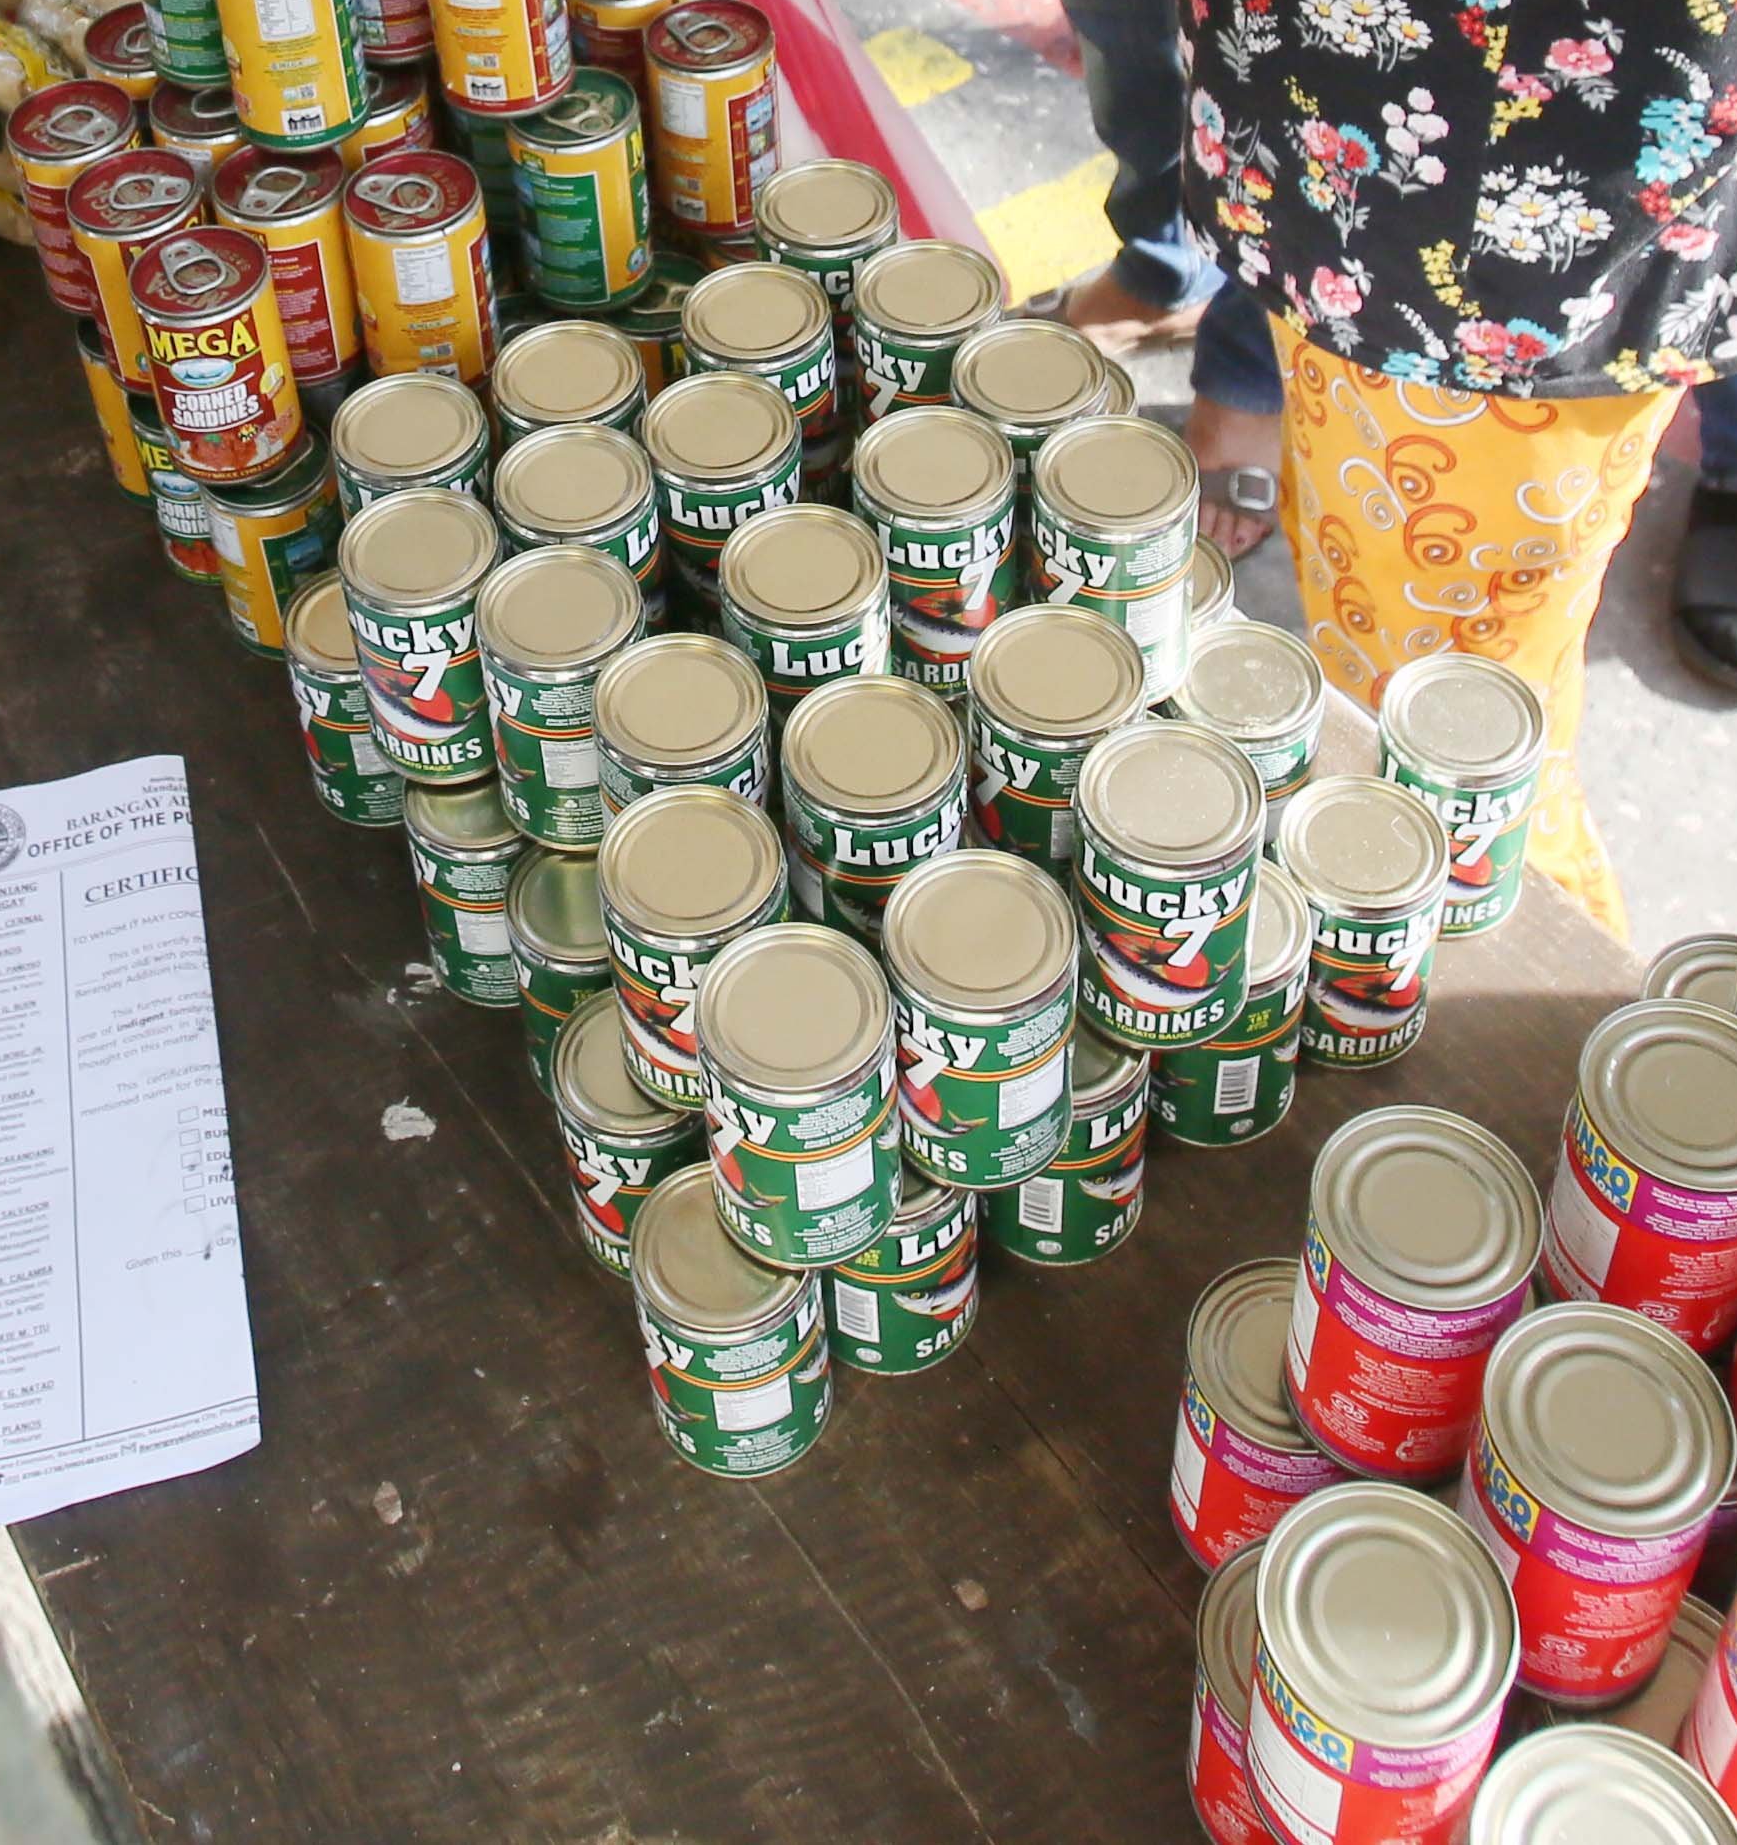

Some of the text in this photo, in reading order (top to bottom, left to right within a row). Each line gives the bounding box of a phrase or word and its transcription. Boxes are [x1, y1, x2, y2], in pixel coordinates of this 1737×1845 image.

[145, 320, 257, 362] MEGA
[172, 395, 260, 429] SARDINES
[174, 383, 248, 411] CORNED
[877, 507, 1014, 570] Lucky
[958, 547, 1002, 611] 7
[1046, 556, 1087, 604] 7
[348, 610, 475, 654] ucky
[402, 649, 451, 702] 7
[27, 831, 96, 859] OFFICE
[99, 822, 124, 841] OF
[130, 812, 167, 832] THE
[66, 796, 162, 832] BARANGAY
[1453, 818, 1506, 868] 7
[1081, 840, 1250, 921] Lucky
[142, 913, 166, 926] MAY
[1162, 909, 1223, 969] 7
[1386, 937, 1428, 994] 7
[117, 1010, 165, 1033] indigent
[660, 986, 697, 1035] 7
[1081, 976, 1226, 1035] SARDINES
[1116, 1022, 1157, 1041] TOMATO
[1158, 1030, 1194, 1042] SAUCE
[1299, 1006, 1426, 1056] SARDINES
[899, 1032, 950, 1091] 7
[580, 1159, 623, 1209] 7
